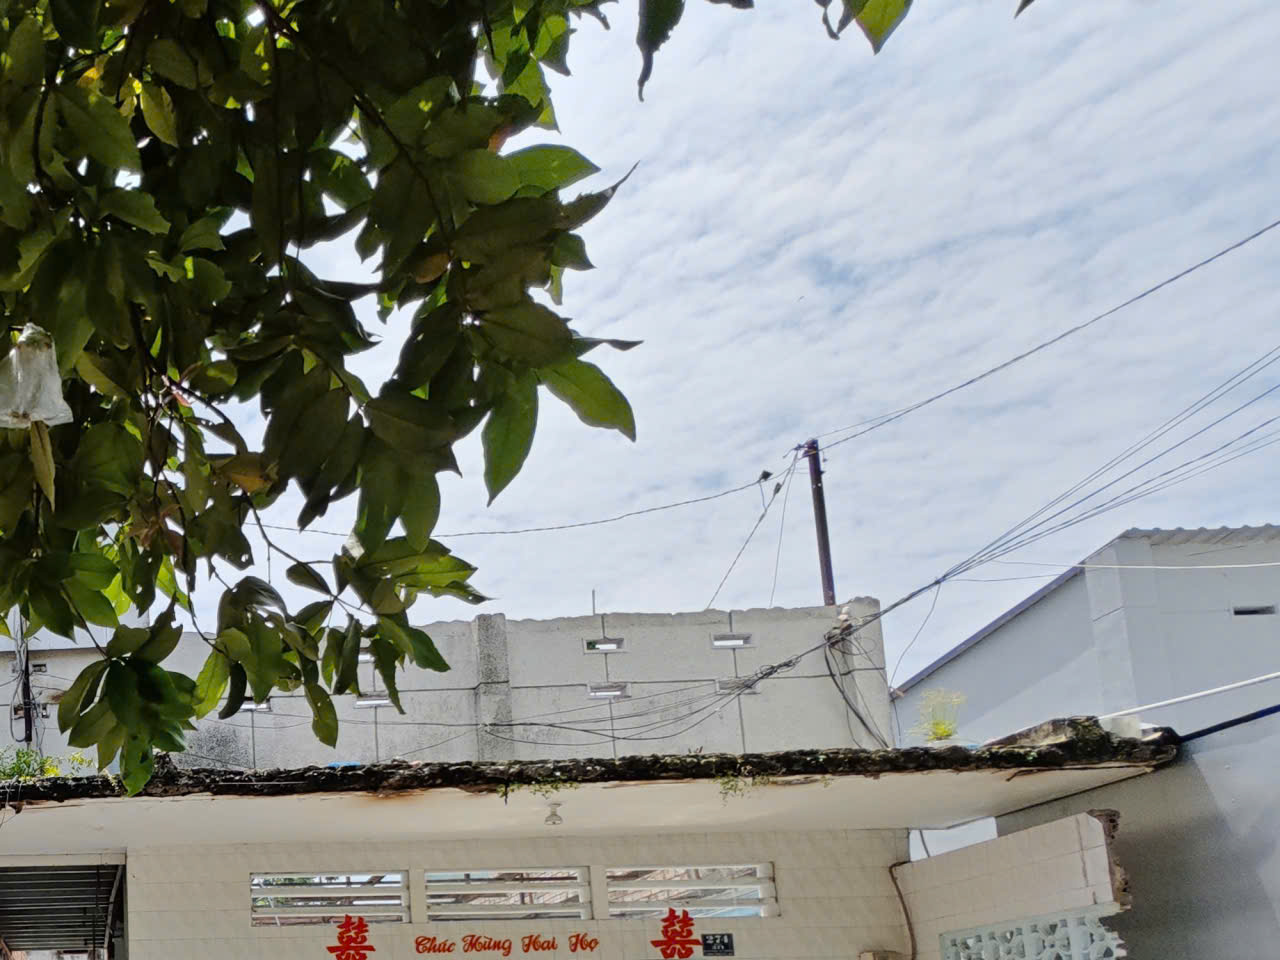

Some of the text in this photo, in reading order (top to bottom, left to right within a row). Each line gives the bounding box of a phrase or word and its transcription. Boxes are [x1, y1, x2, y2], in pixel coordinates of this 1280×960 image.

[415, 935, 456, 954] Chúc
[521, 933, 558, 953] Hai
[568, 932, 599, 953] Họ
